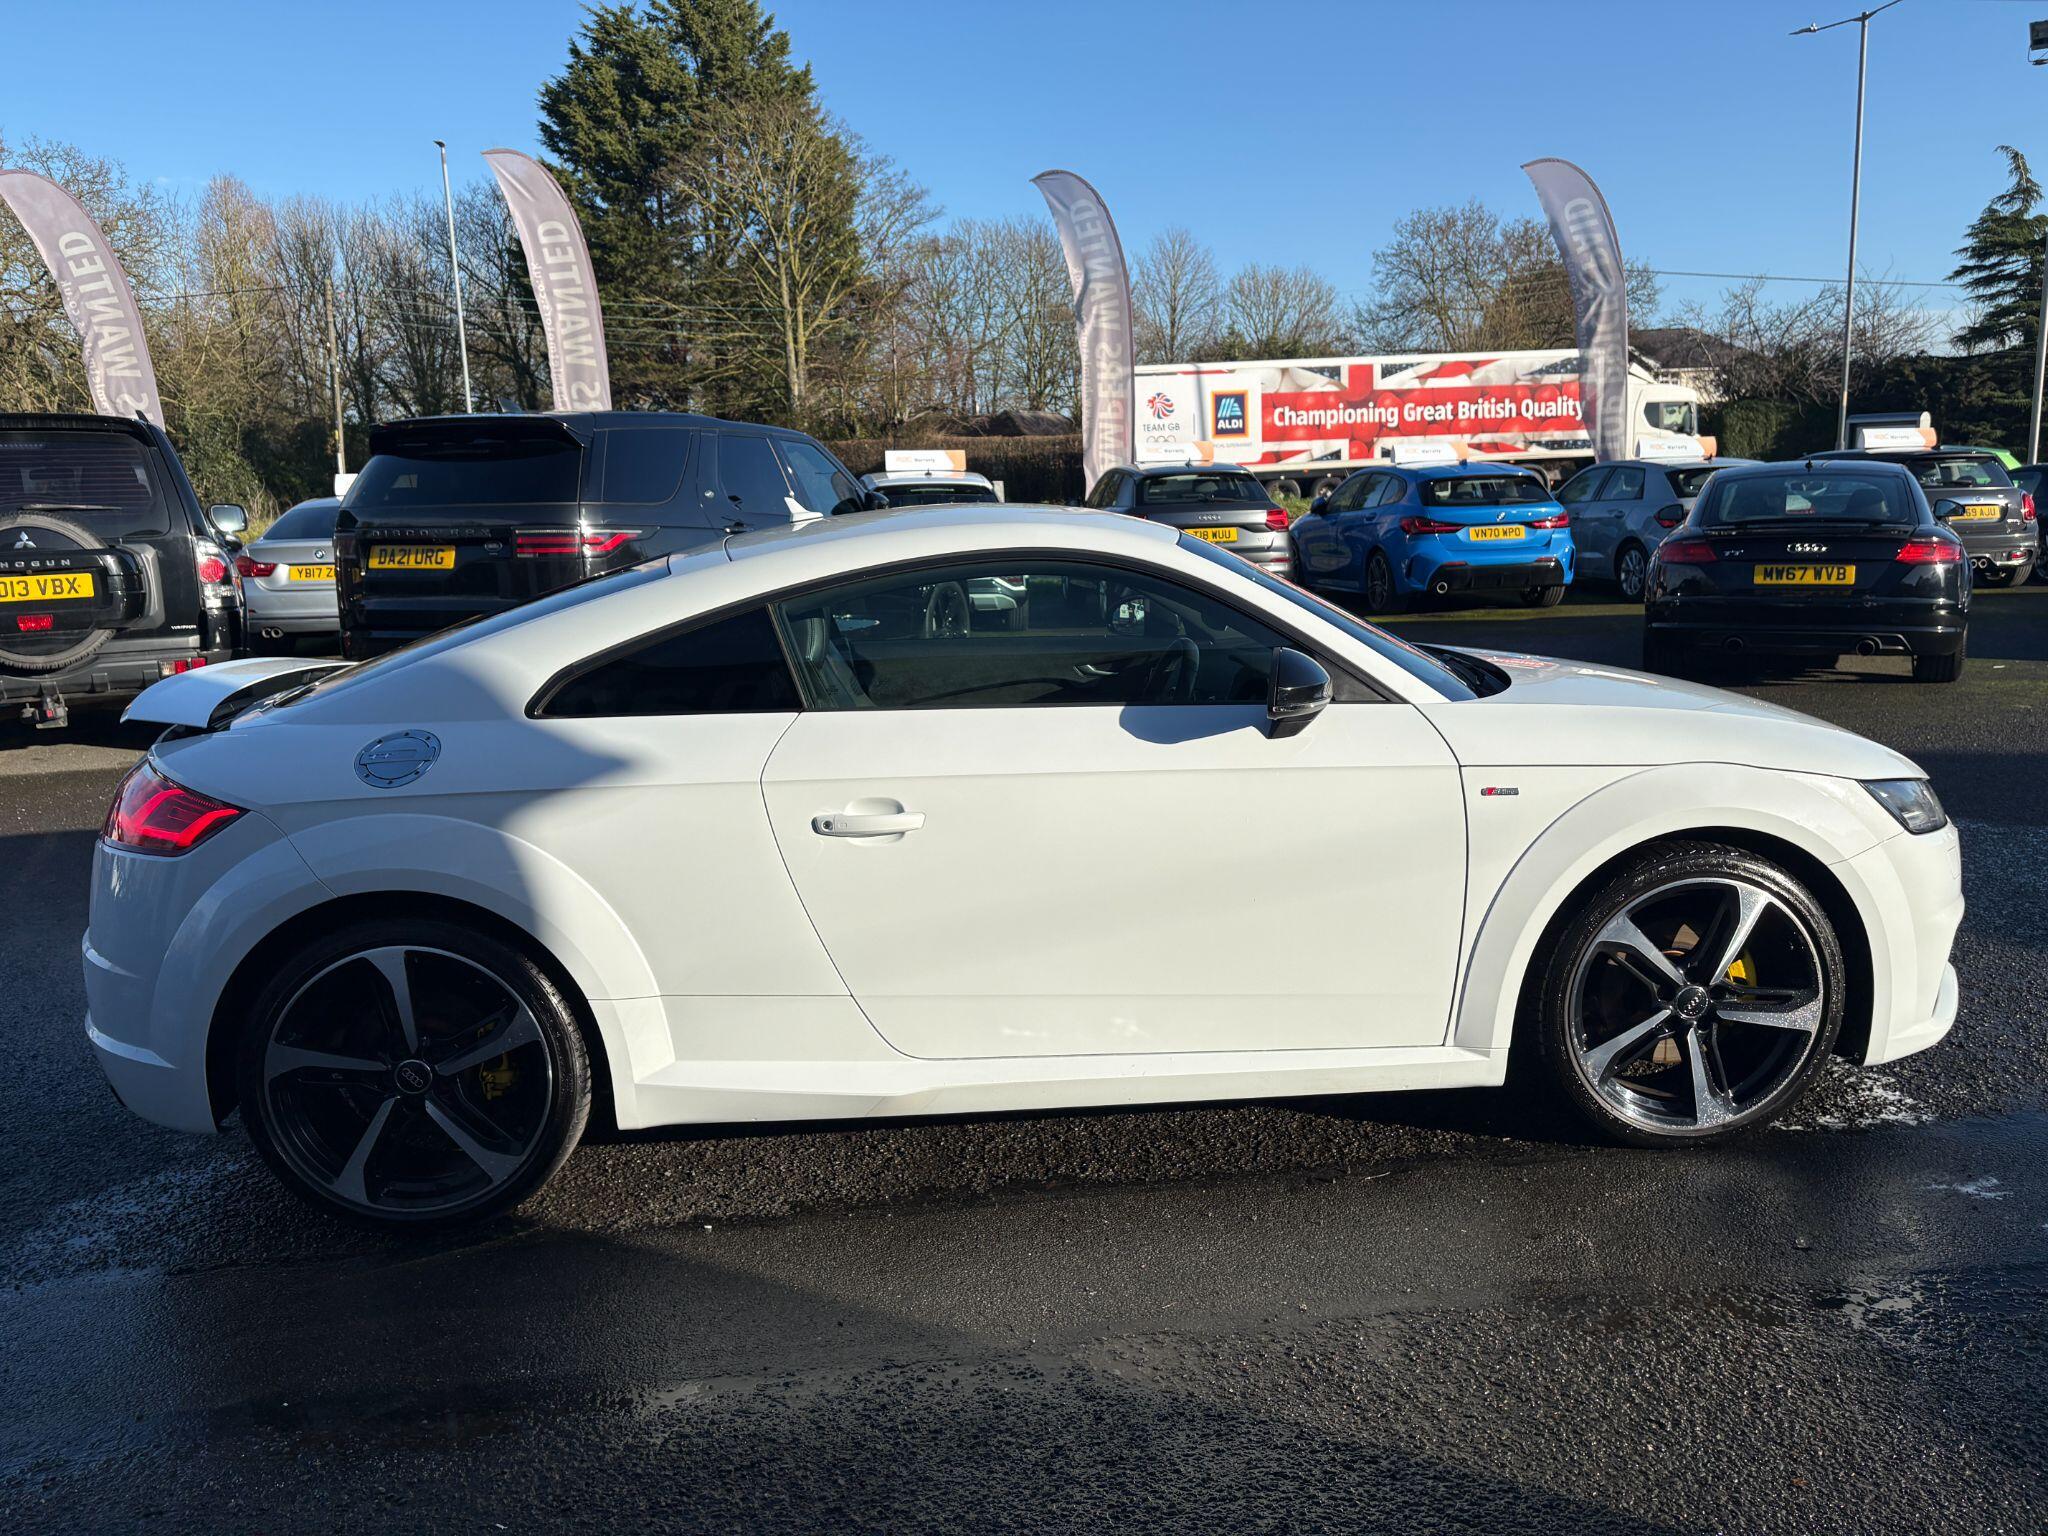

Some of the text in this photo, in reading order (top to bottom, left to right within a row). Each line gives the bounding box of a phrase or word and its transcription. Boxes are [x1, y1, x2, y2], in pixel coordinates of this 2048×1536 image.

[1274, 395, 1583, 429] Championing Great British Quality
[1143, 423, 1180, 432] TEAM GB
[1217, 418, 1243, 430] ALDI
[1979, 506, 1996, 517] AJU
[1193, 529, 1231, 541] T18 WUU
[1474, 527, 1521, 539] VN70 WPO
[378, 548, 445, 566] DA21 URG
[0, 558, 71, 569] HOGUN
[297, 567, 336, 579] YB17 Z
[1763, 567, 1847, 582] MW67 WVB
[36, 577, 80, 596] VBX
